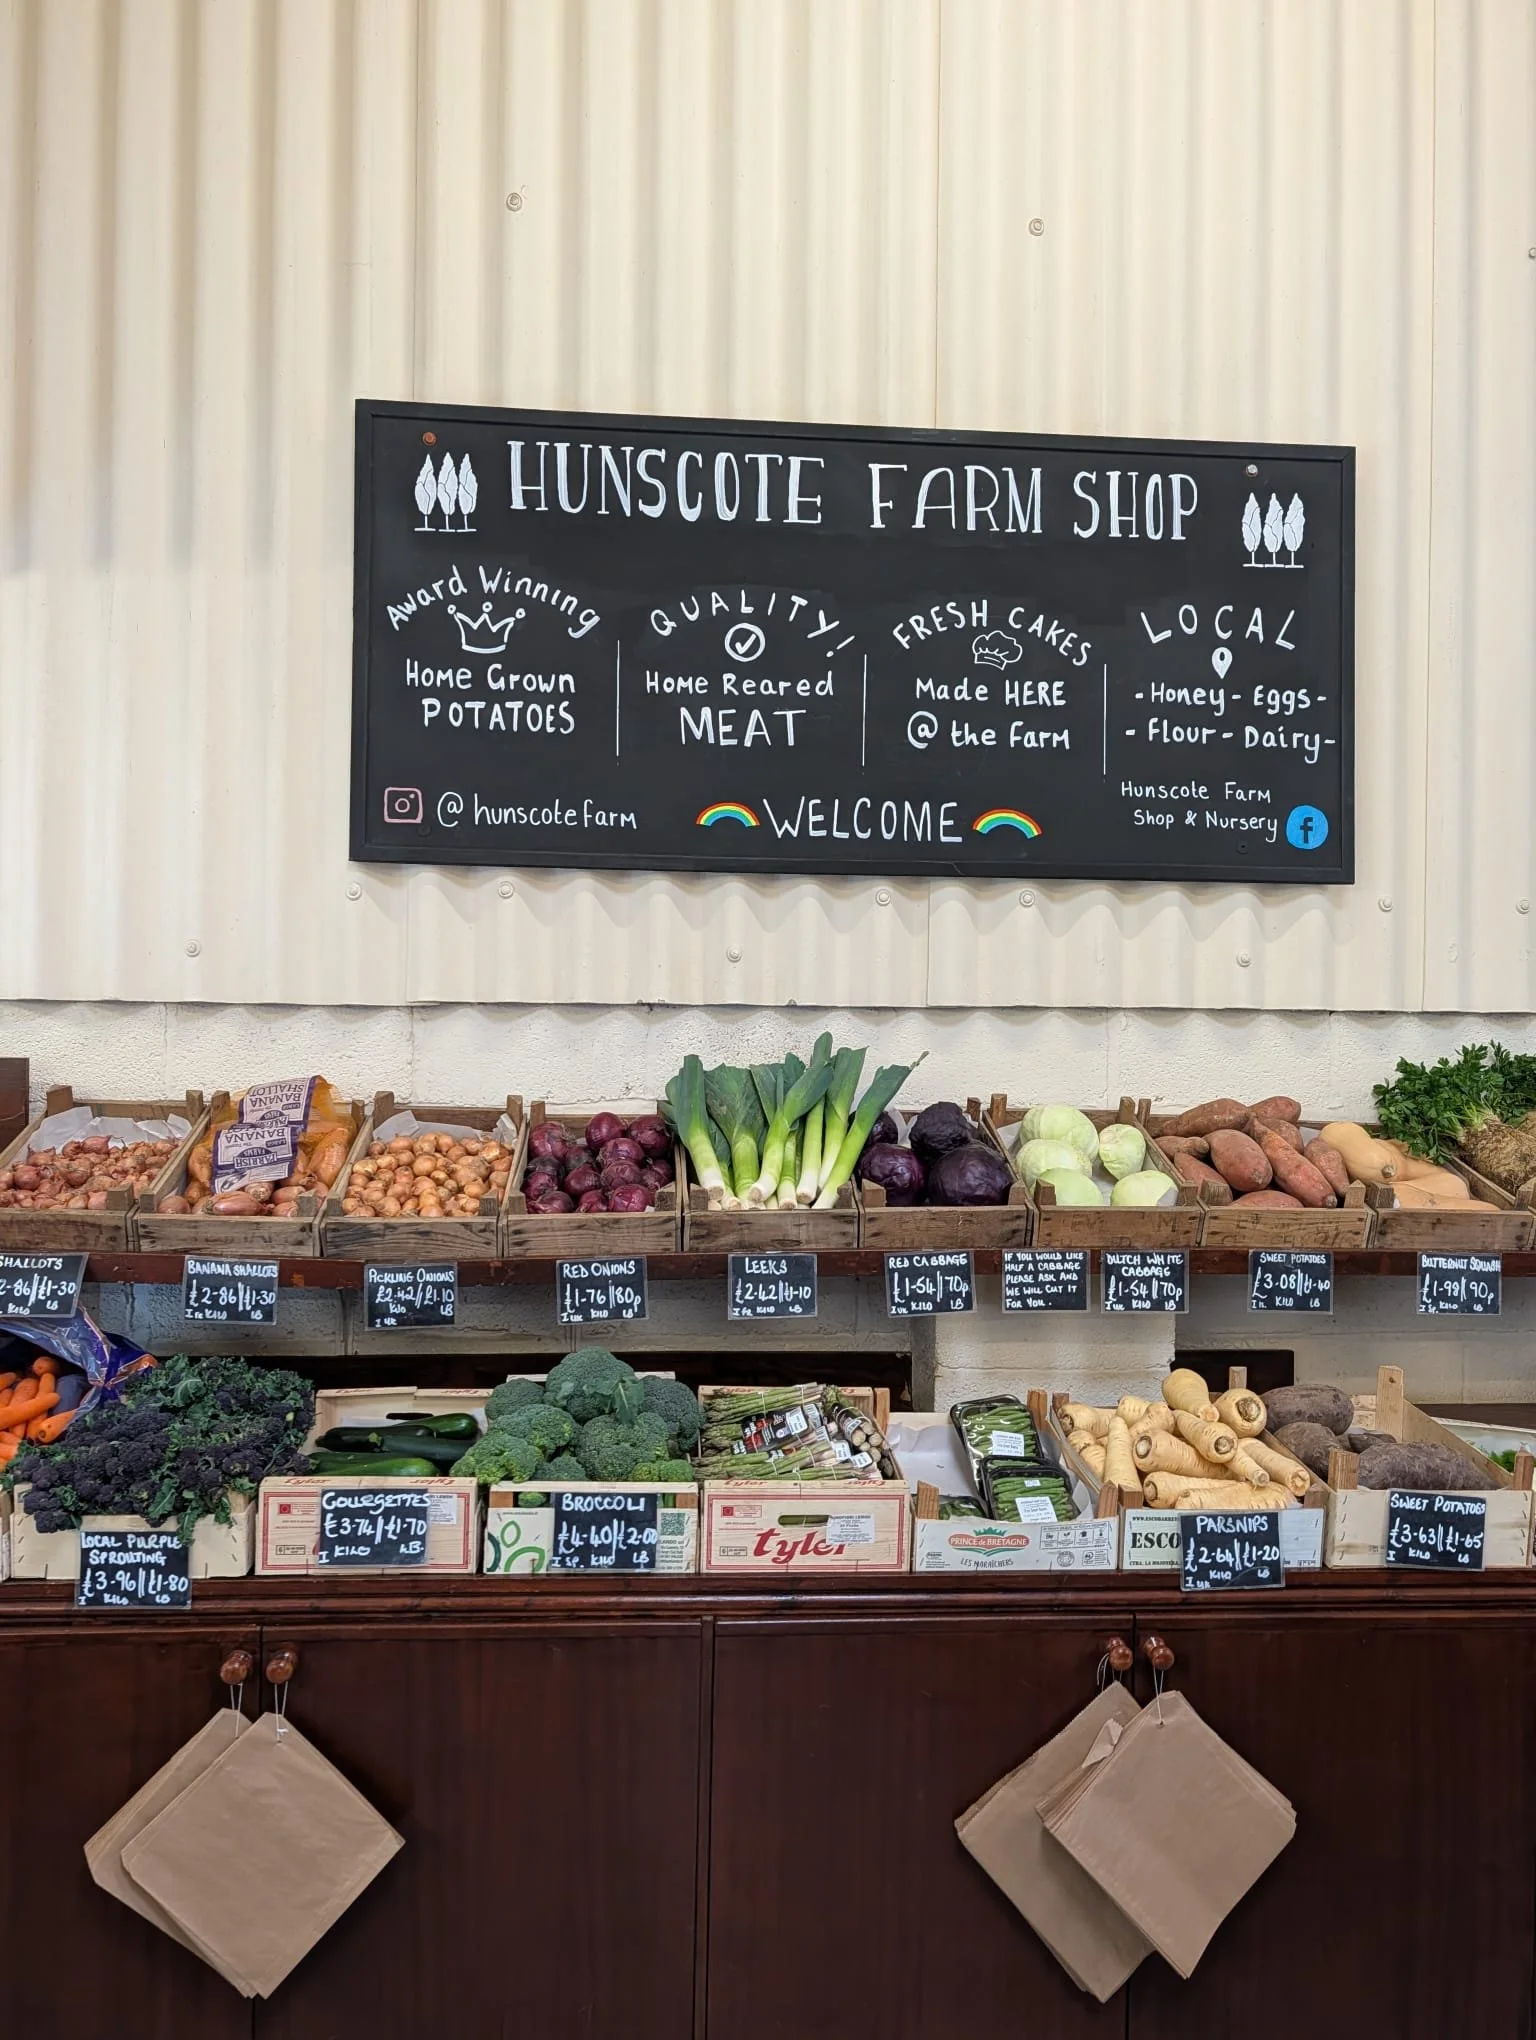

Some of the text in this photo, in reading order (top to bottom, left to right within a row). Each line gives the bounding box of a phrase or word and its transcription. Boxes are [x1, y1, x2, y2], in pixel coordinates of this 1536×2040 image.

[507, 441, 1197, 540] HUNSCOTE FARM SHOP
[387, 565, 600, 638] Award Winning
[893, 600, 1091, 666] FRESH CAKES
[1141, 605, 1295, 649] LOCAL
[487, 663, 576, 693] Grown
[723, 671, 833, 697] Reared
[916, 678, 1066, 707] Made HERE
[422, 698, 575, 734] POTATOES
[680, 708, 805, 747] MEAT
[907, 710, 938, 748] @
[951, 720, 997, 746] the
[1121, 781, 1271, 803] Hunscote Farm
[763, 796, 963, 843] WELCOME
[1134, 810, 1277, 842] Shop & Nursery
[250, 1092, 301, 1108] BANANA
[225, 1127, 285, 1144] BANANA
[889, 1253, 967, 1269] RED CABBAGE
[1005, 1253, 1013, 1261] IF
[1016, 1252, 1033, 1261] YOU
[1036, 1252, 1062, 1260] WOULD
[1106, 1252, 1183, 1265] DUTCH WHITE
[1260, 1252, 1326, 1264] SWEET POTATOES
[1422, 1255, 1468, 1269] BUTTERNUT
[188, 1260, 232, 1276] BANANA
[417, 1268, 454, 1282] ONIONS
[563, 1260, 635, 1278] RED ONIONS
[745, 1257, 787, 1275] LEEKS
[1005, 1262, 1081, 1272] HALF A CABBAGE
[1122, 1266, 1170, 1278] CABBAGE
[1006, 1274, 1034, 1284] PLEASE
[1060, 1272, 1078, 1280] AND
[1006, 1287, 1020, 1296] WE
[1045, 1285, 1063, 1293] CUT
[1068, 1285, 1077, 1293] IT
[1006, 1299, 1022, 1308] FOR
[322, 1492, 431, 1515] COURGETTES
[562, 1493, 645, 1512] BROCCOLI
[1390, 1494, 1486, 1515] SWEET POTATOES
[1196, 1515, 1268, 1534] PARSNIPS
[81, 1532, 182, 1549] LOCAL PURPLE
[951, 1537, 977, 1545] PRINCE
[89, 1549, 167, 1567] SPROUTING
[334, 1545, 371, 1557] KILO
